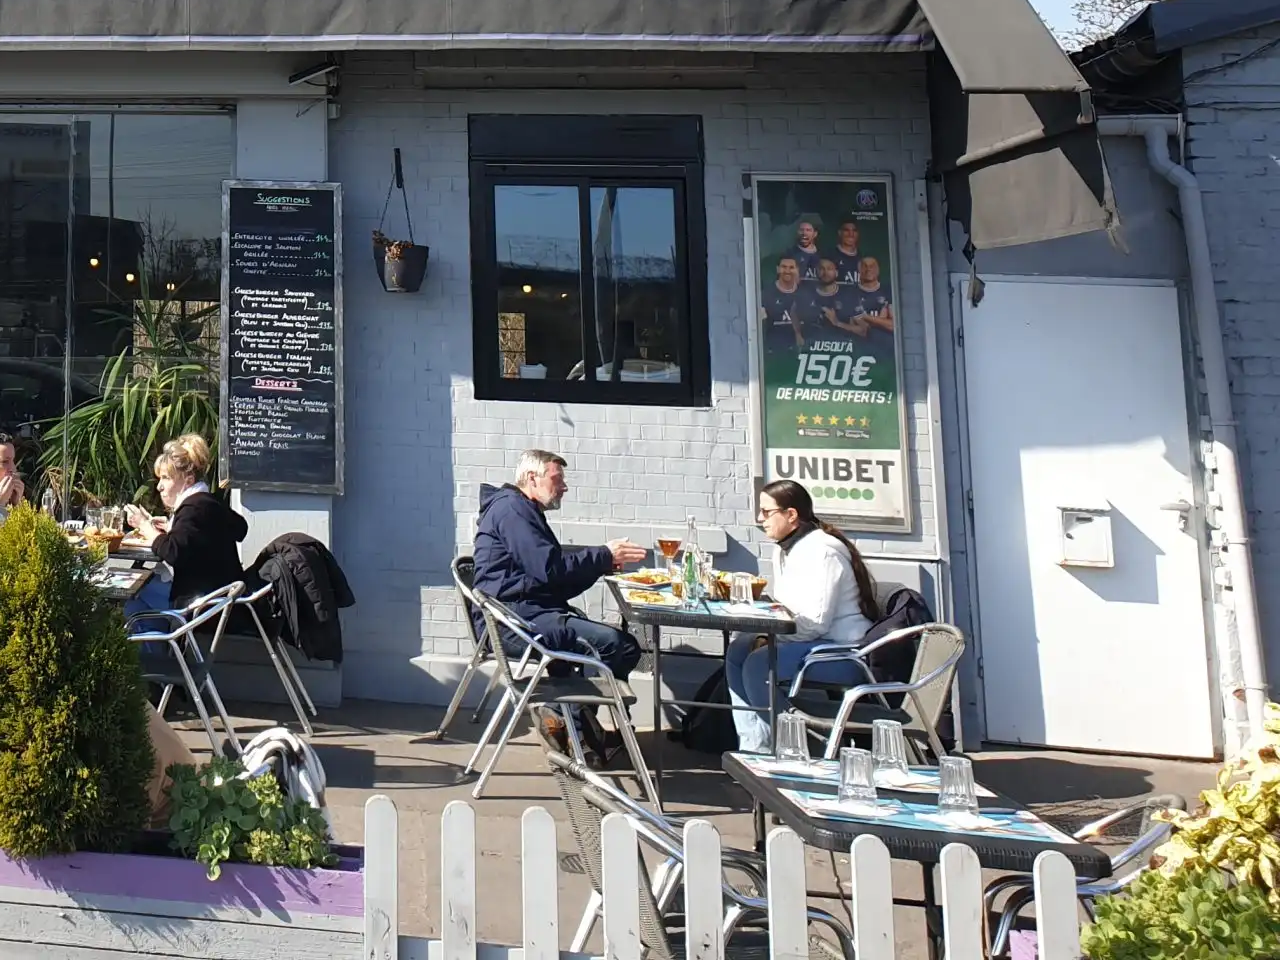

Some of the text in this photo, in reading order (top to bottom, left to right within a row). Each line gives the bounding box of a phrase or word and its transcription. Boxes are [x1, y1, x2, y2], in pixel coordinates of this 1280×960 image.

[257, 193, 310, 203] SUGGESTIONS
[810, 340, 853, 352] JUSQU'À
[795, 354, 876, 386] 150€
[255, 378, 298, 388] DESSERTS
[776, 388, 793, 400] DE
[794, 388, 830, 401] PARIS
[832, 389, 885, 403] OFFERTS
[776, 455, 895, 484] UNIBET
